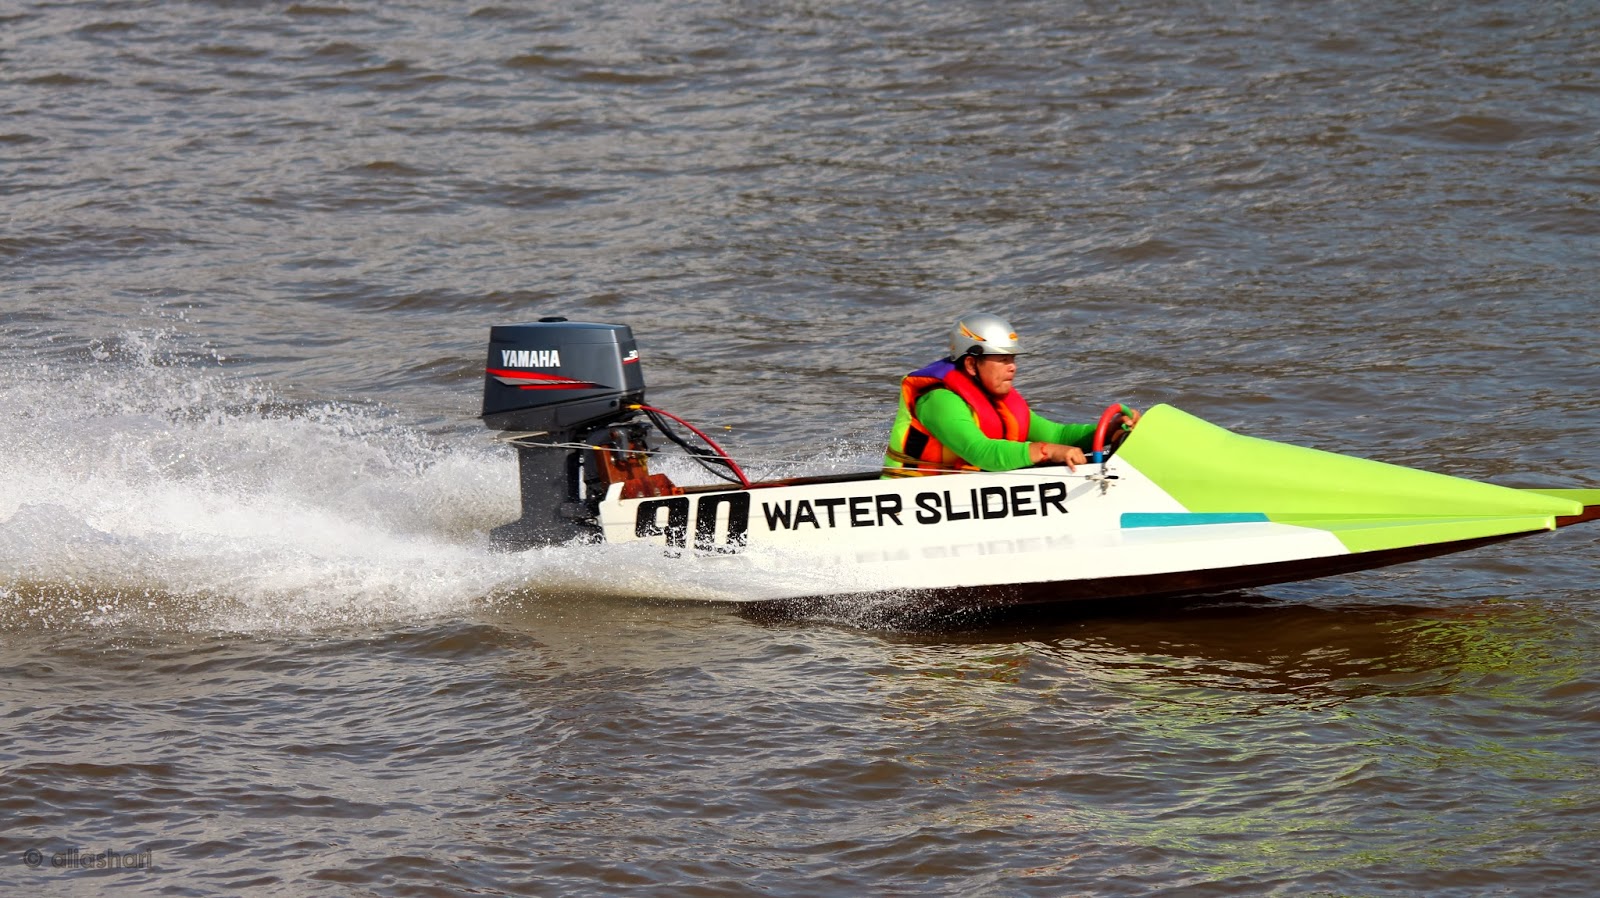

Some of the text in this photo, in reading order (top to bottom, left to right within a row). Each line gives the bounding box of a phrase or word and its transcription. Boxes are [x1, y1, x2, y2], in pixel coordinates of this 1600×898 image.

[501, 350, 561, 368] YAMAHA
[762, 481, 1069, 531] WATER SLIDER
